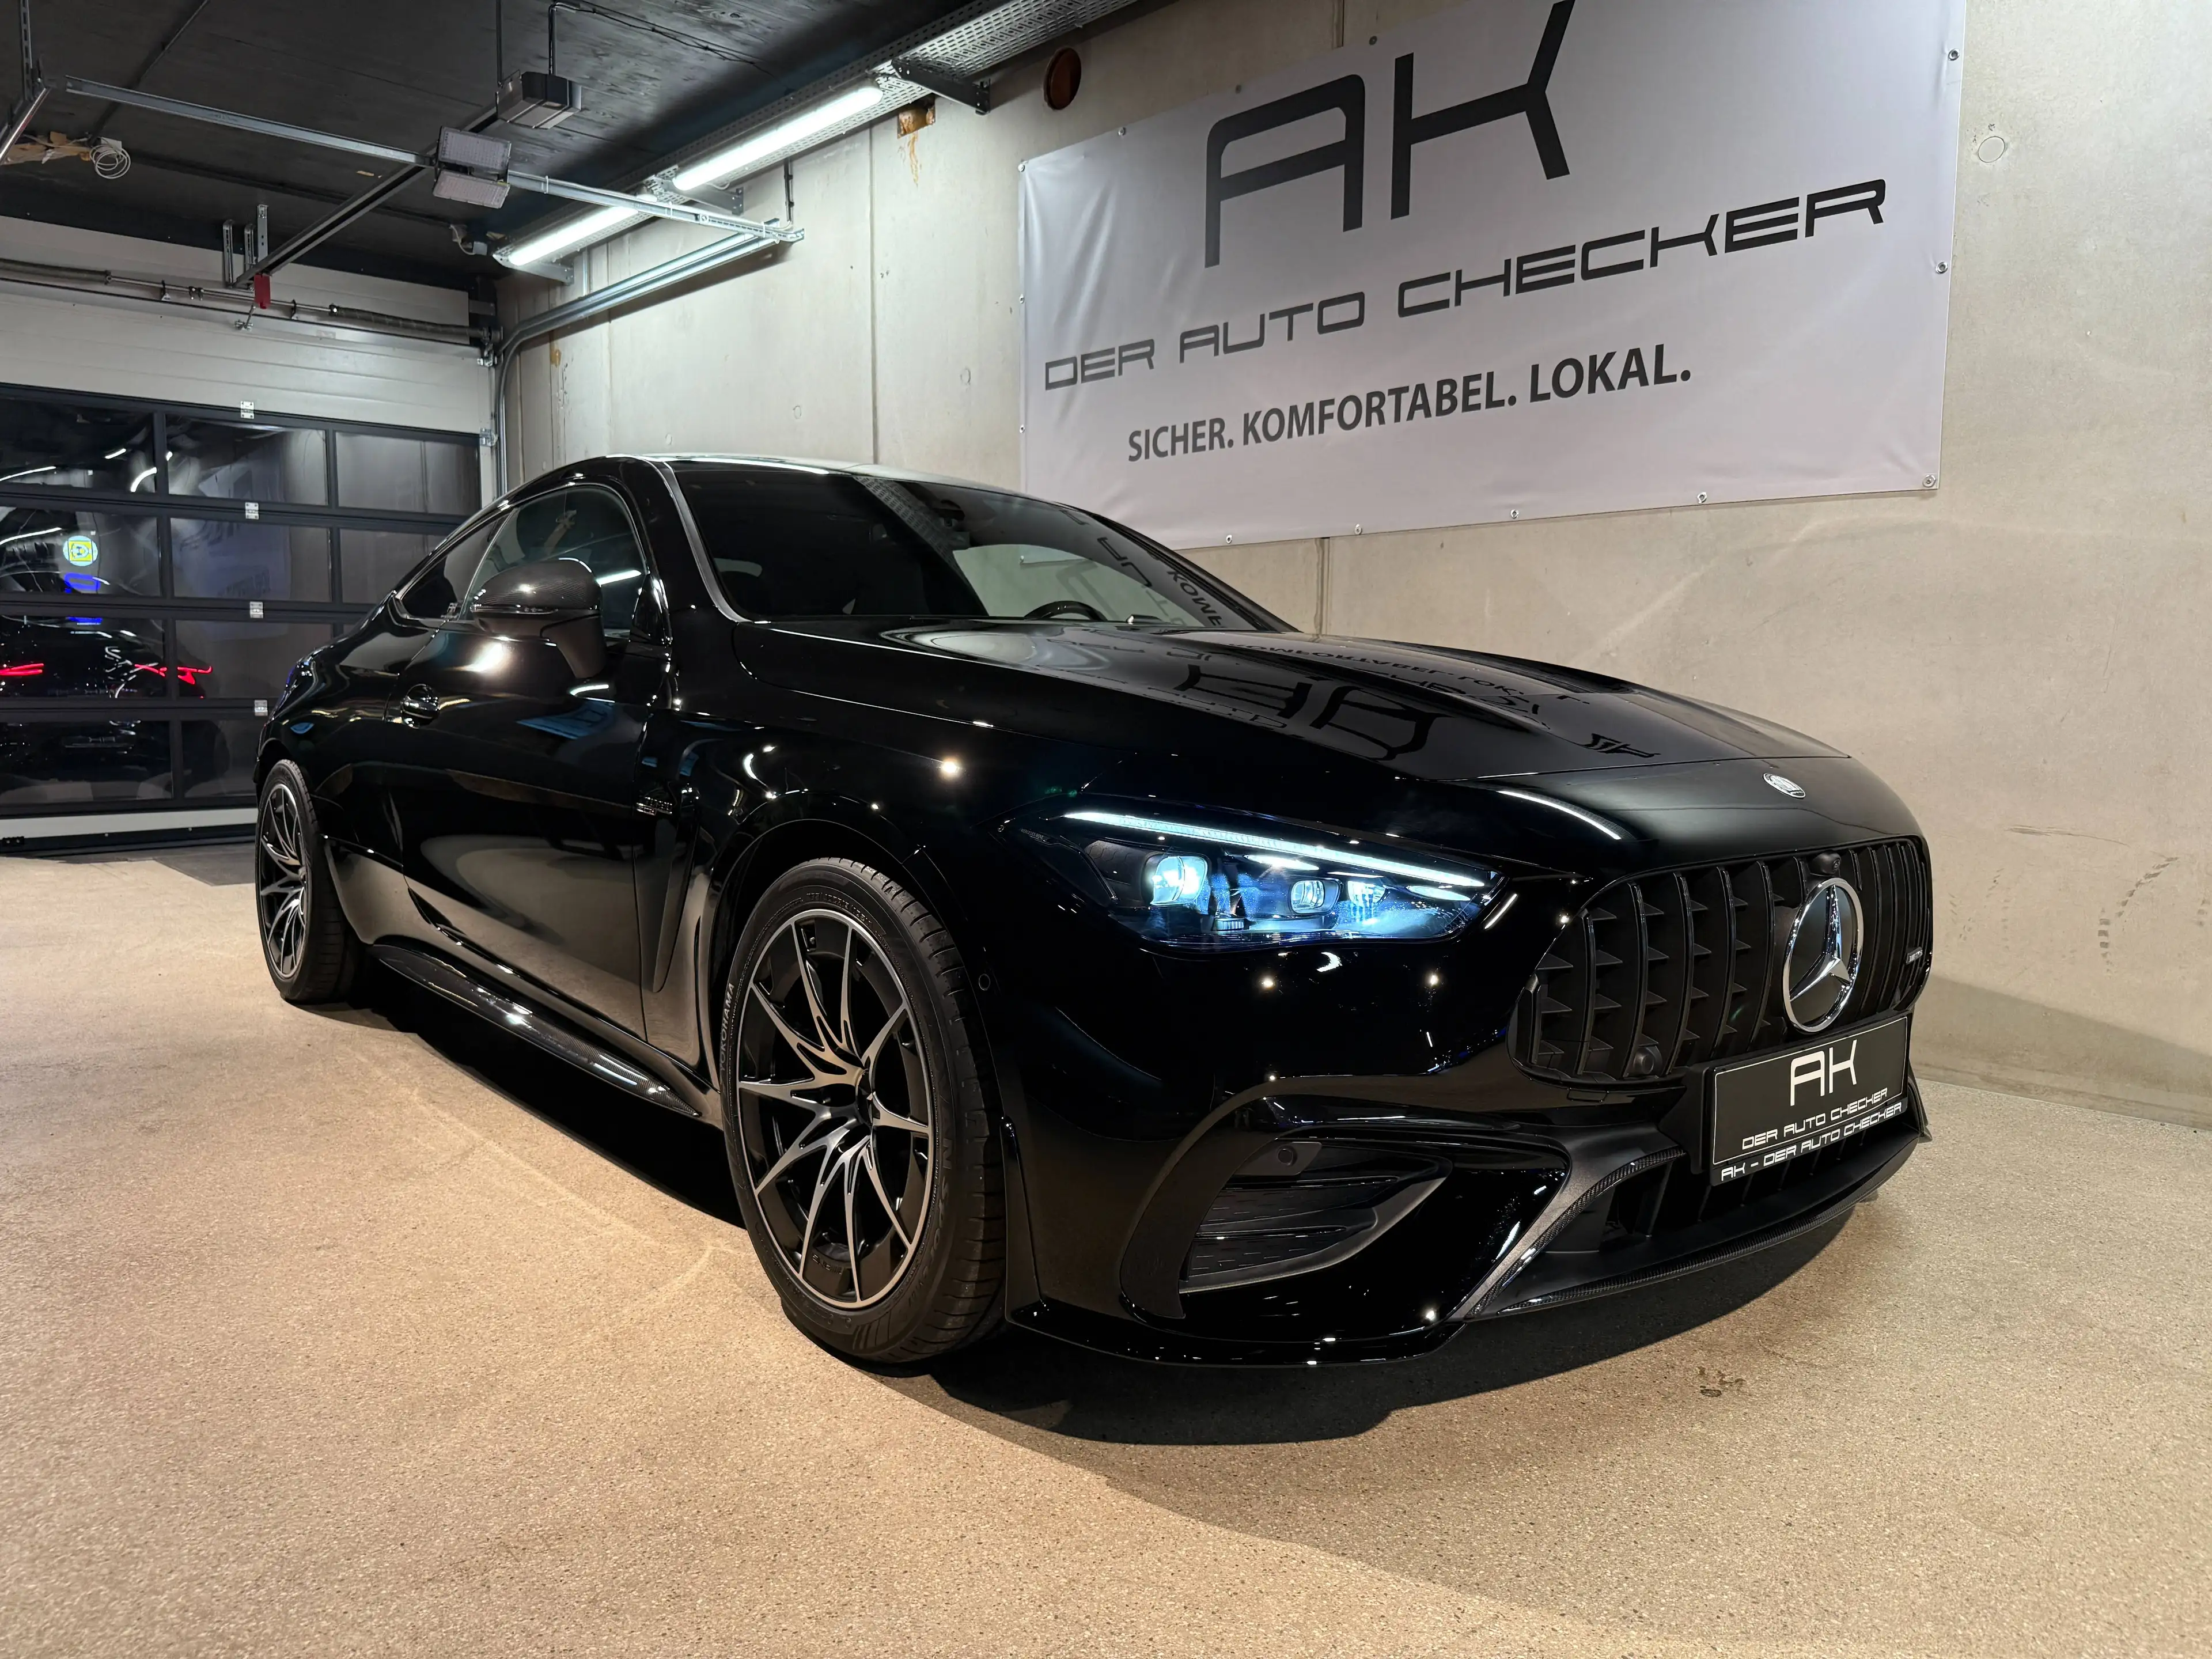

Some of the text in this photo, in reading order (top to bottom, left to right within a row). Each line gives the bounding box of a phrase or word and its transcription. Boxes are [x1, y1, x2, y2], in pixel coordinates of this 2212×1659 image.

[1205, 0, 1574, 268] AK
[1045, 179, 1886, 391] DER AUTO CHECKER
[1128, 343, 1691, 462] SICHER. KOMFORTABEL. LOKAL.
[720, 983, 734, 1071] YOKOHAMA
[1790, 1039, 1857, 1107] AK
[1721, 1162, 1746, 1181] AK
[1763, 1145, 1797, 1167] DER
[1801, 1128, 1840, 1153] AUTO
[1843, 1101, 1902, 1136] CHECKER
[1742, 1087, 1888, 1150] DER AUTO CHECKER
